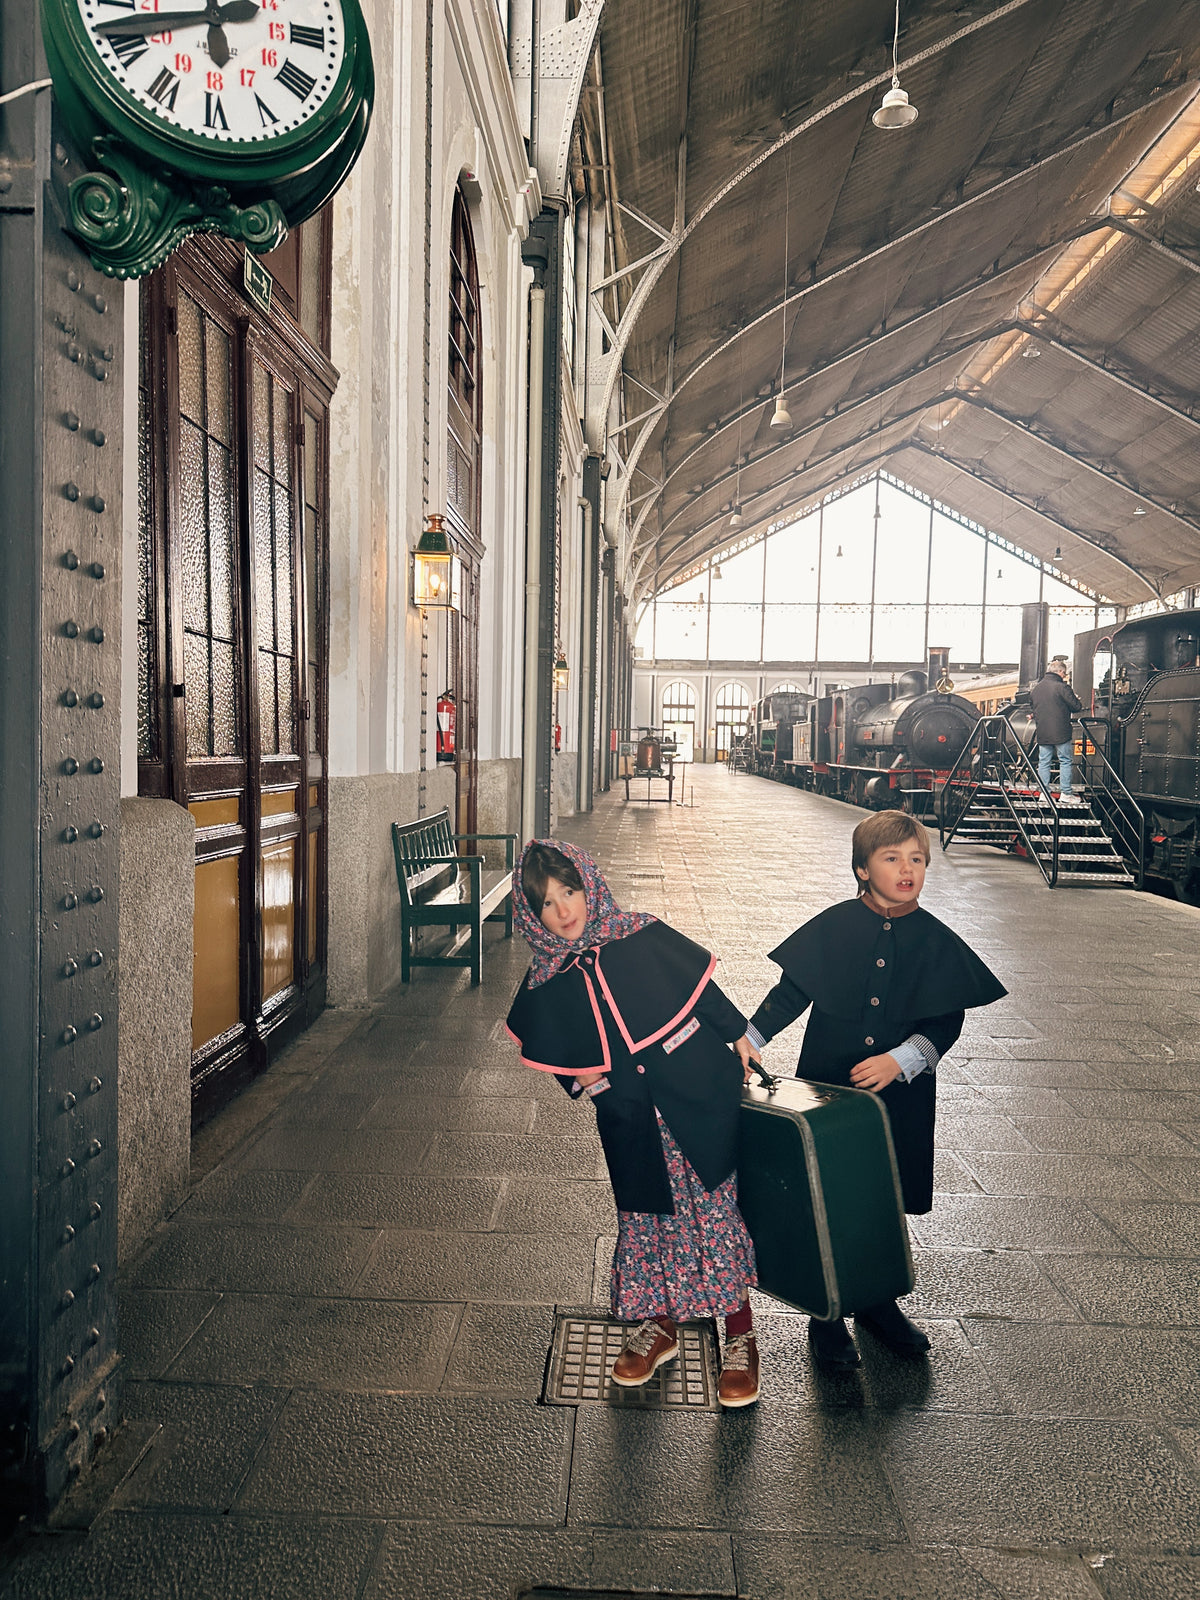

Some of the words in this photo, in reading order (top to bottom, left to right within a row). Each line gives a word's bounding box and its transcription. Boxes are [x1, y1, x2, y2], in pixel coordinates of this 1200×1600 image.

[268, 22, 285, 41] 15
[289, 21, 325, 53] III
[175, 53, 192, 73] 19
[261, 47, 278, 68] 16
[206, 71, 224, 92] 18
[240, 68, 256, 88] 17
[203, 91, 231, 131] VI
[254, 91, 281, 128] V
